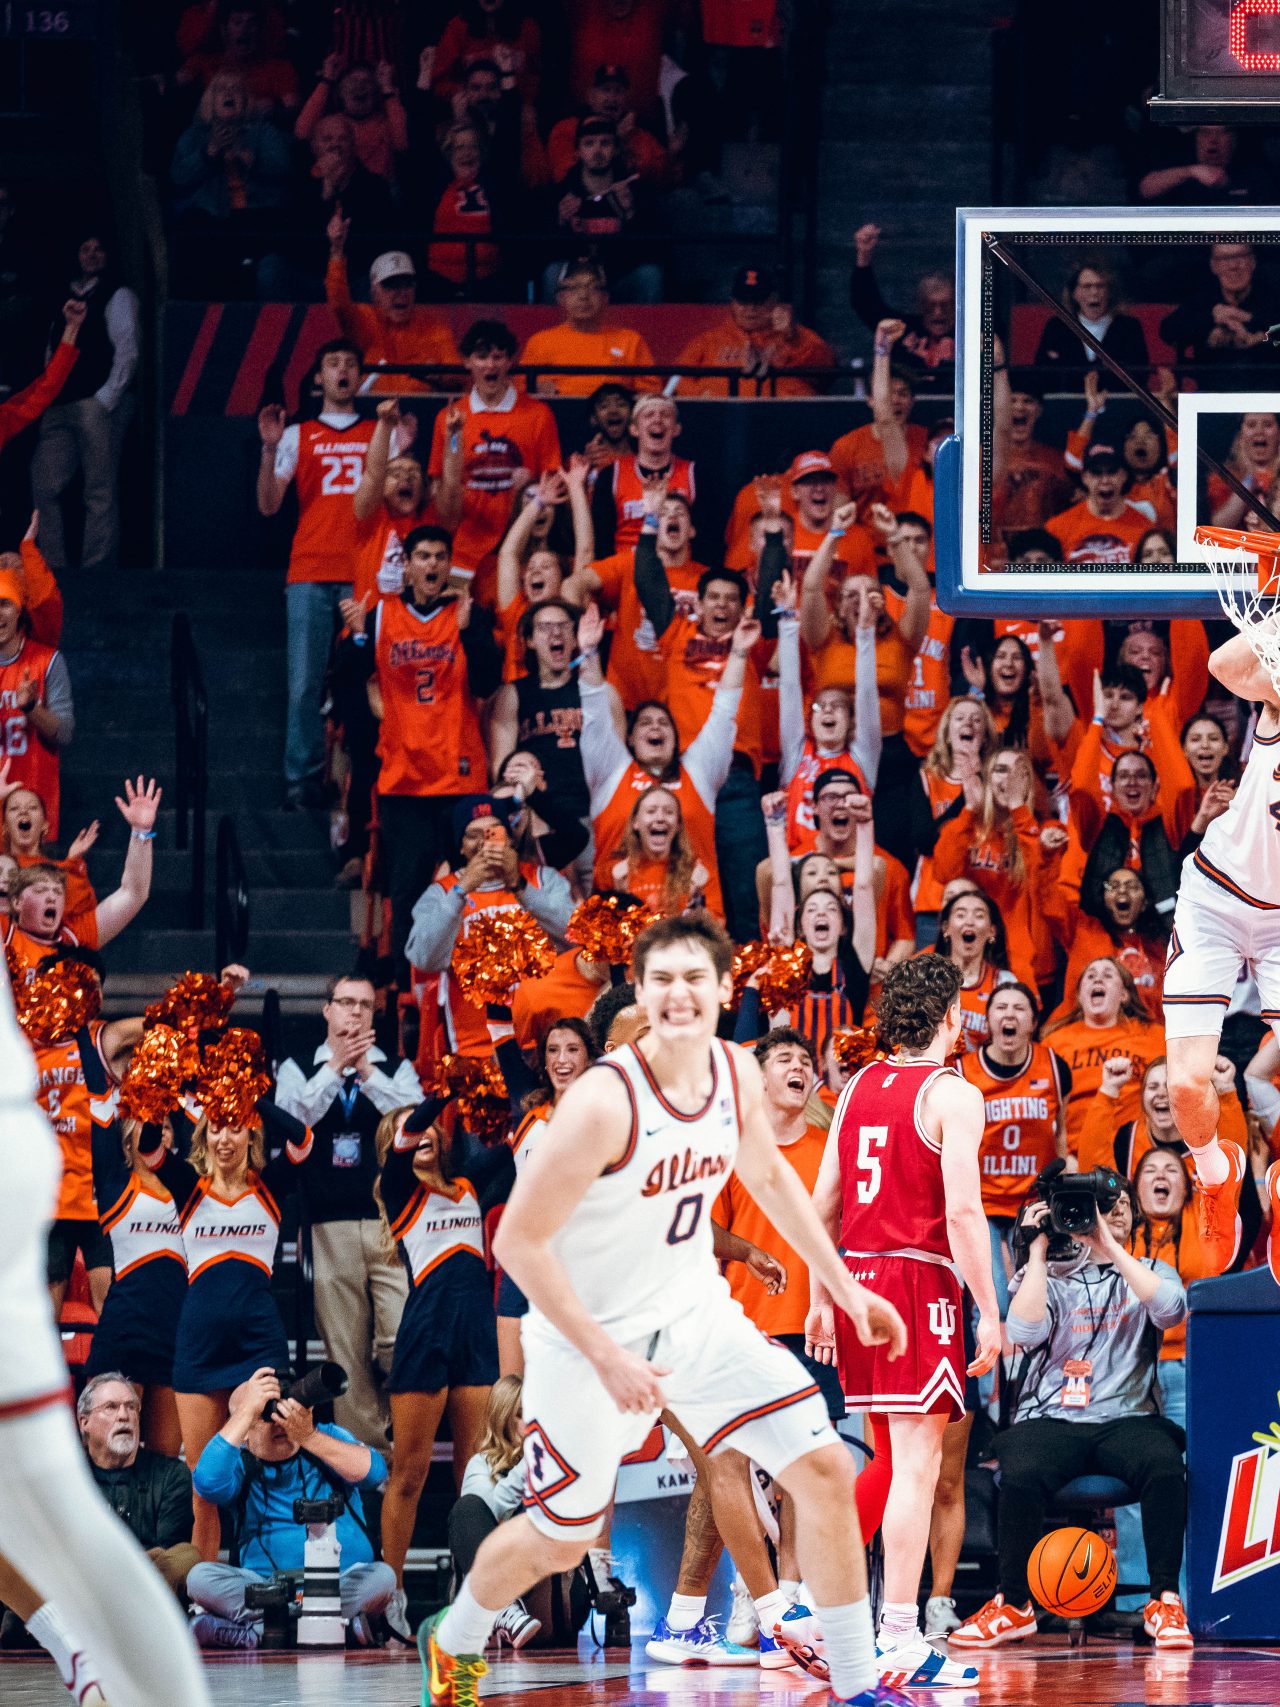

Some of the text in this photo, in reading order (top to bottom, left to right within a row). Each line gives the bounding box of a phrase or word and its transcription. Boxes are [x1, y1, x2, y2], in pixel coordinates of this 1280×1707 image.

[26, 11, 69, 32] 136
[321, 455, 363, 495] 23
[416, 670, 435, 705] 2
[1003, 1123, 1021, 1151] 0
[856, 1125, 889, 1205] 5
[983, 1154, 1037, 1176] ILLINI
[194, 1224, 267, 1239] ILLINOIS
[426, 1217, 479, 1233] ILLINOIS
[667, 1194, 703, 1245] 0
